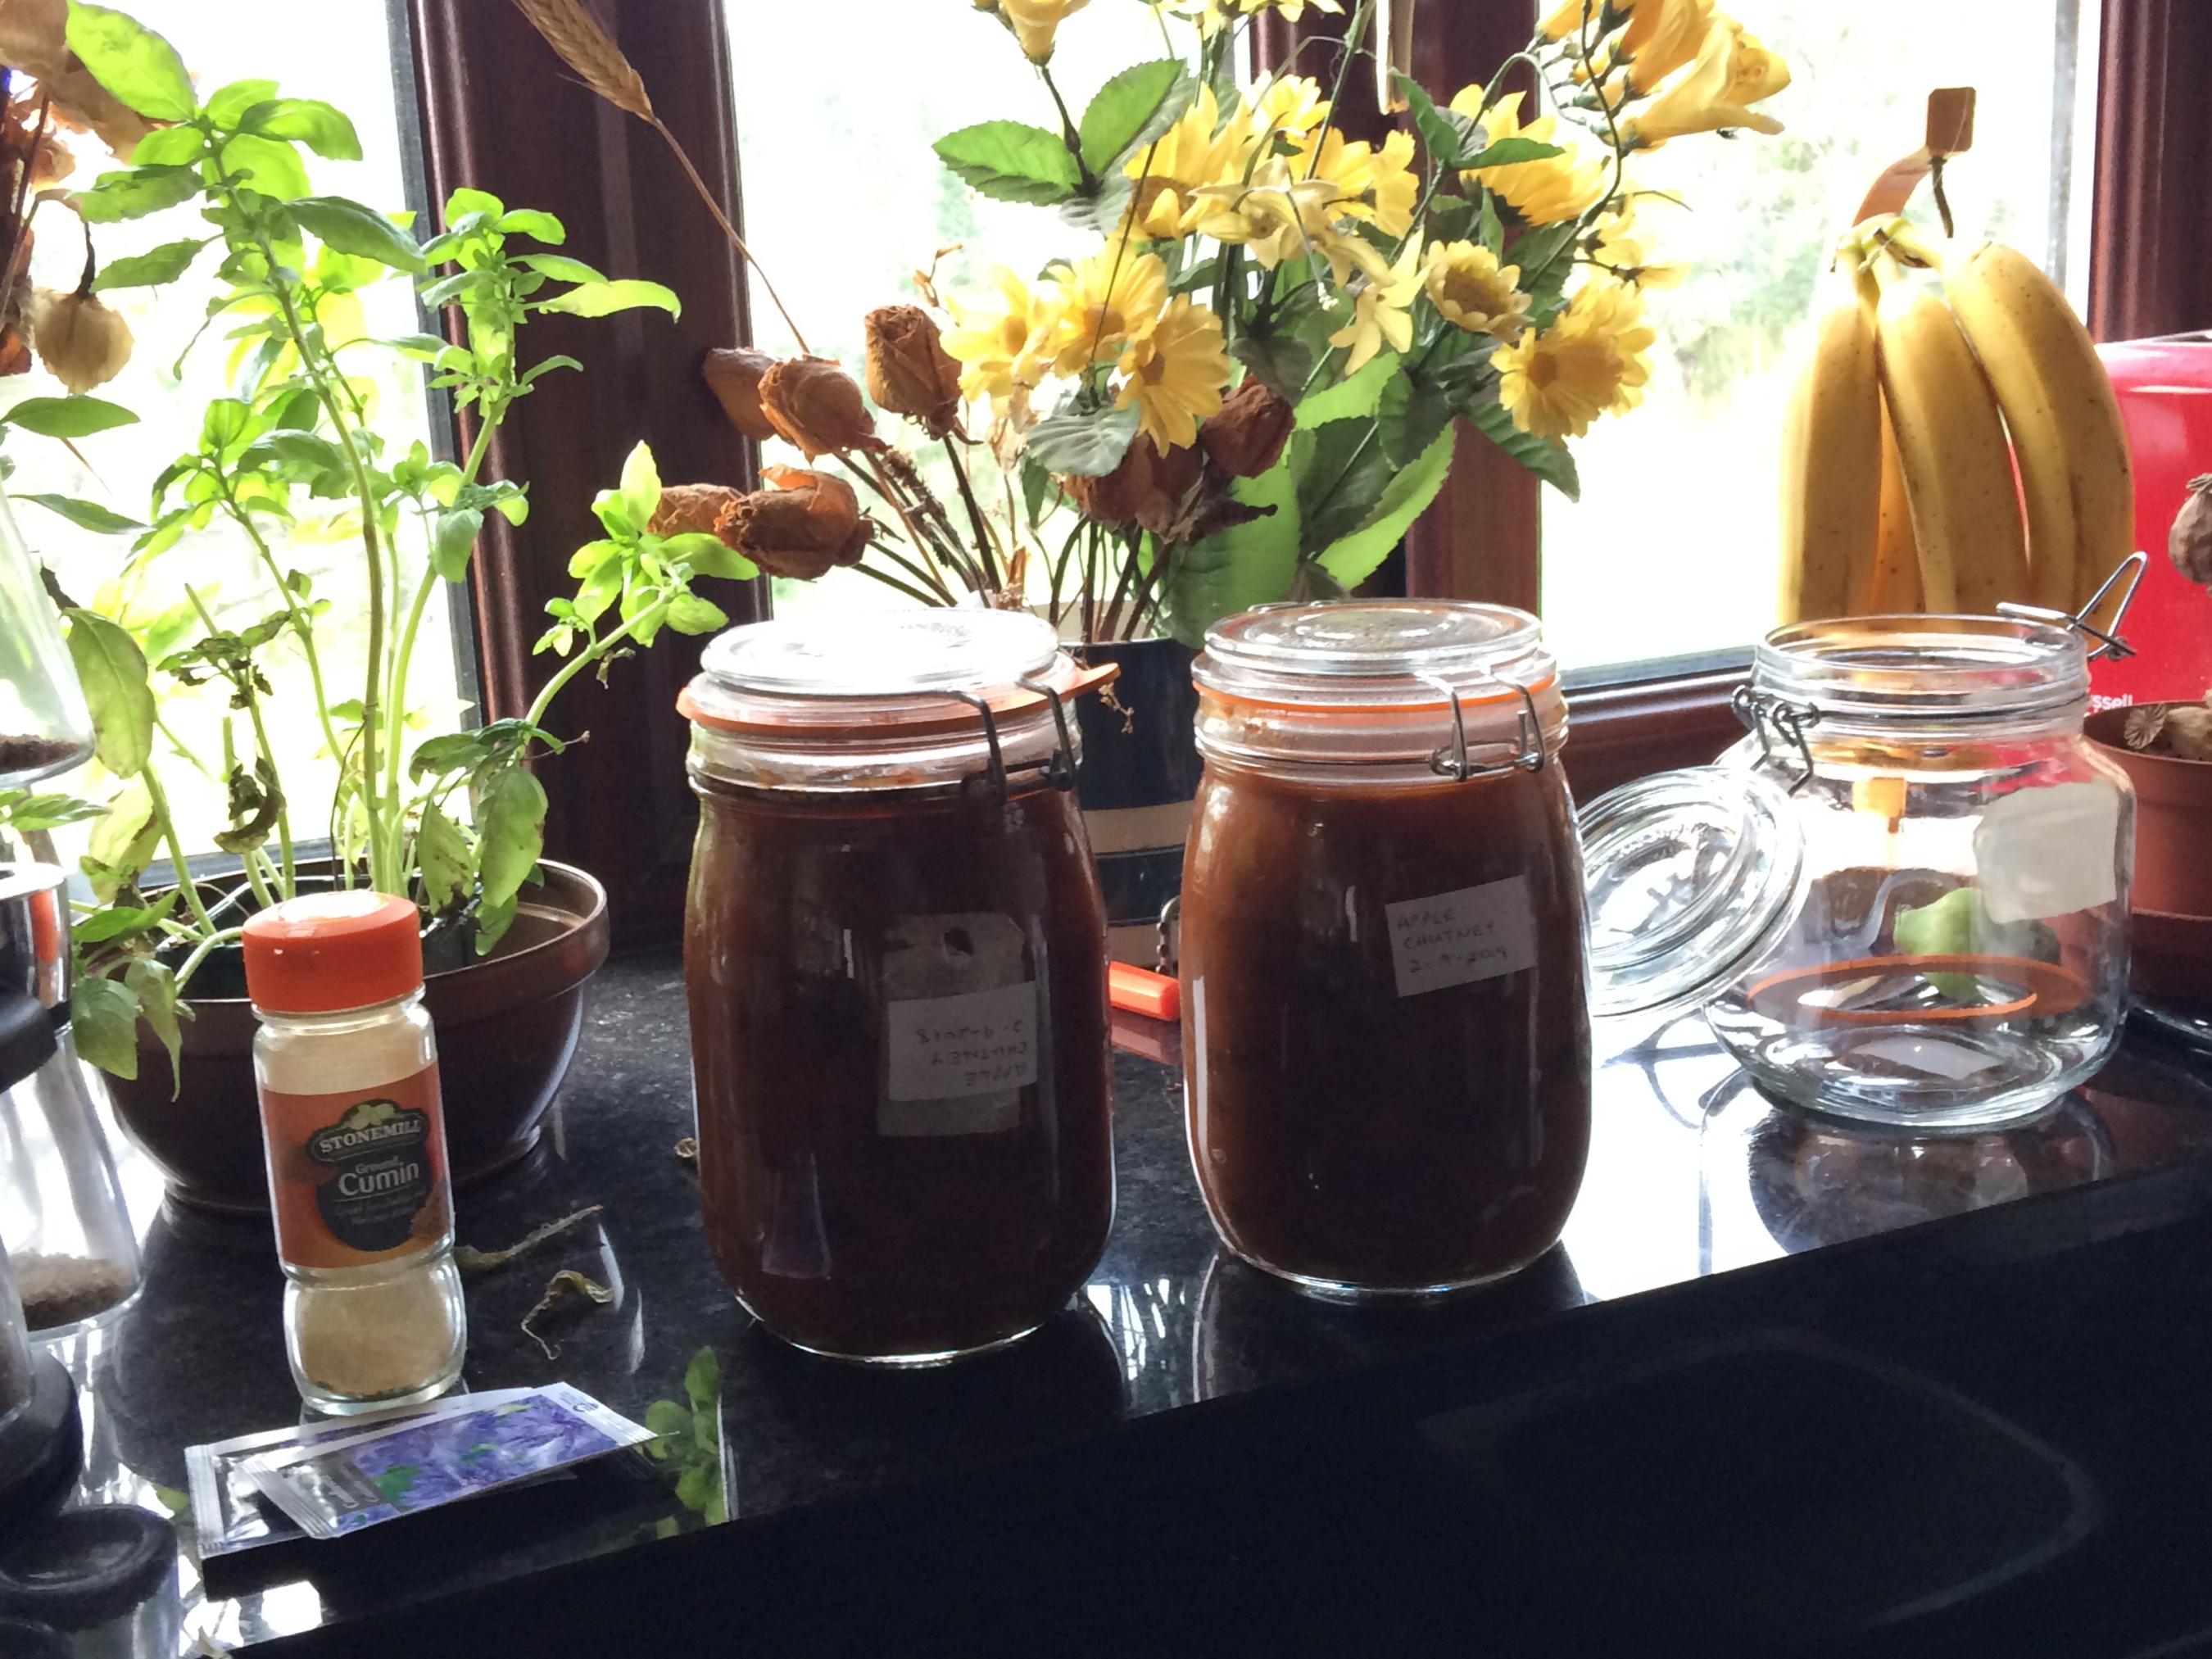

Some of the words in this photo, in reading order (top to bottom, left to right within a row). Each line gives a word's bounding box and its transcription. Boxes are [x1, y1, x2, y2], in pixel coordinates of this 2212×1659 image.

[2092, 694, 2133, 709] ssell
[1398, 908, 1453, 930] APPLE
[1403, 920, 1494, 950] CHUTNEY
[931, 1040, 1027, 1066] CHUTNEY
[963, 1062, 1027, 1088] APPLE
[320, 1120, 420, 1154] STONEMILL
[338, 1162, 419, 1196] Cumin
